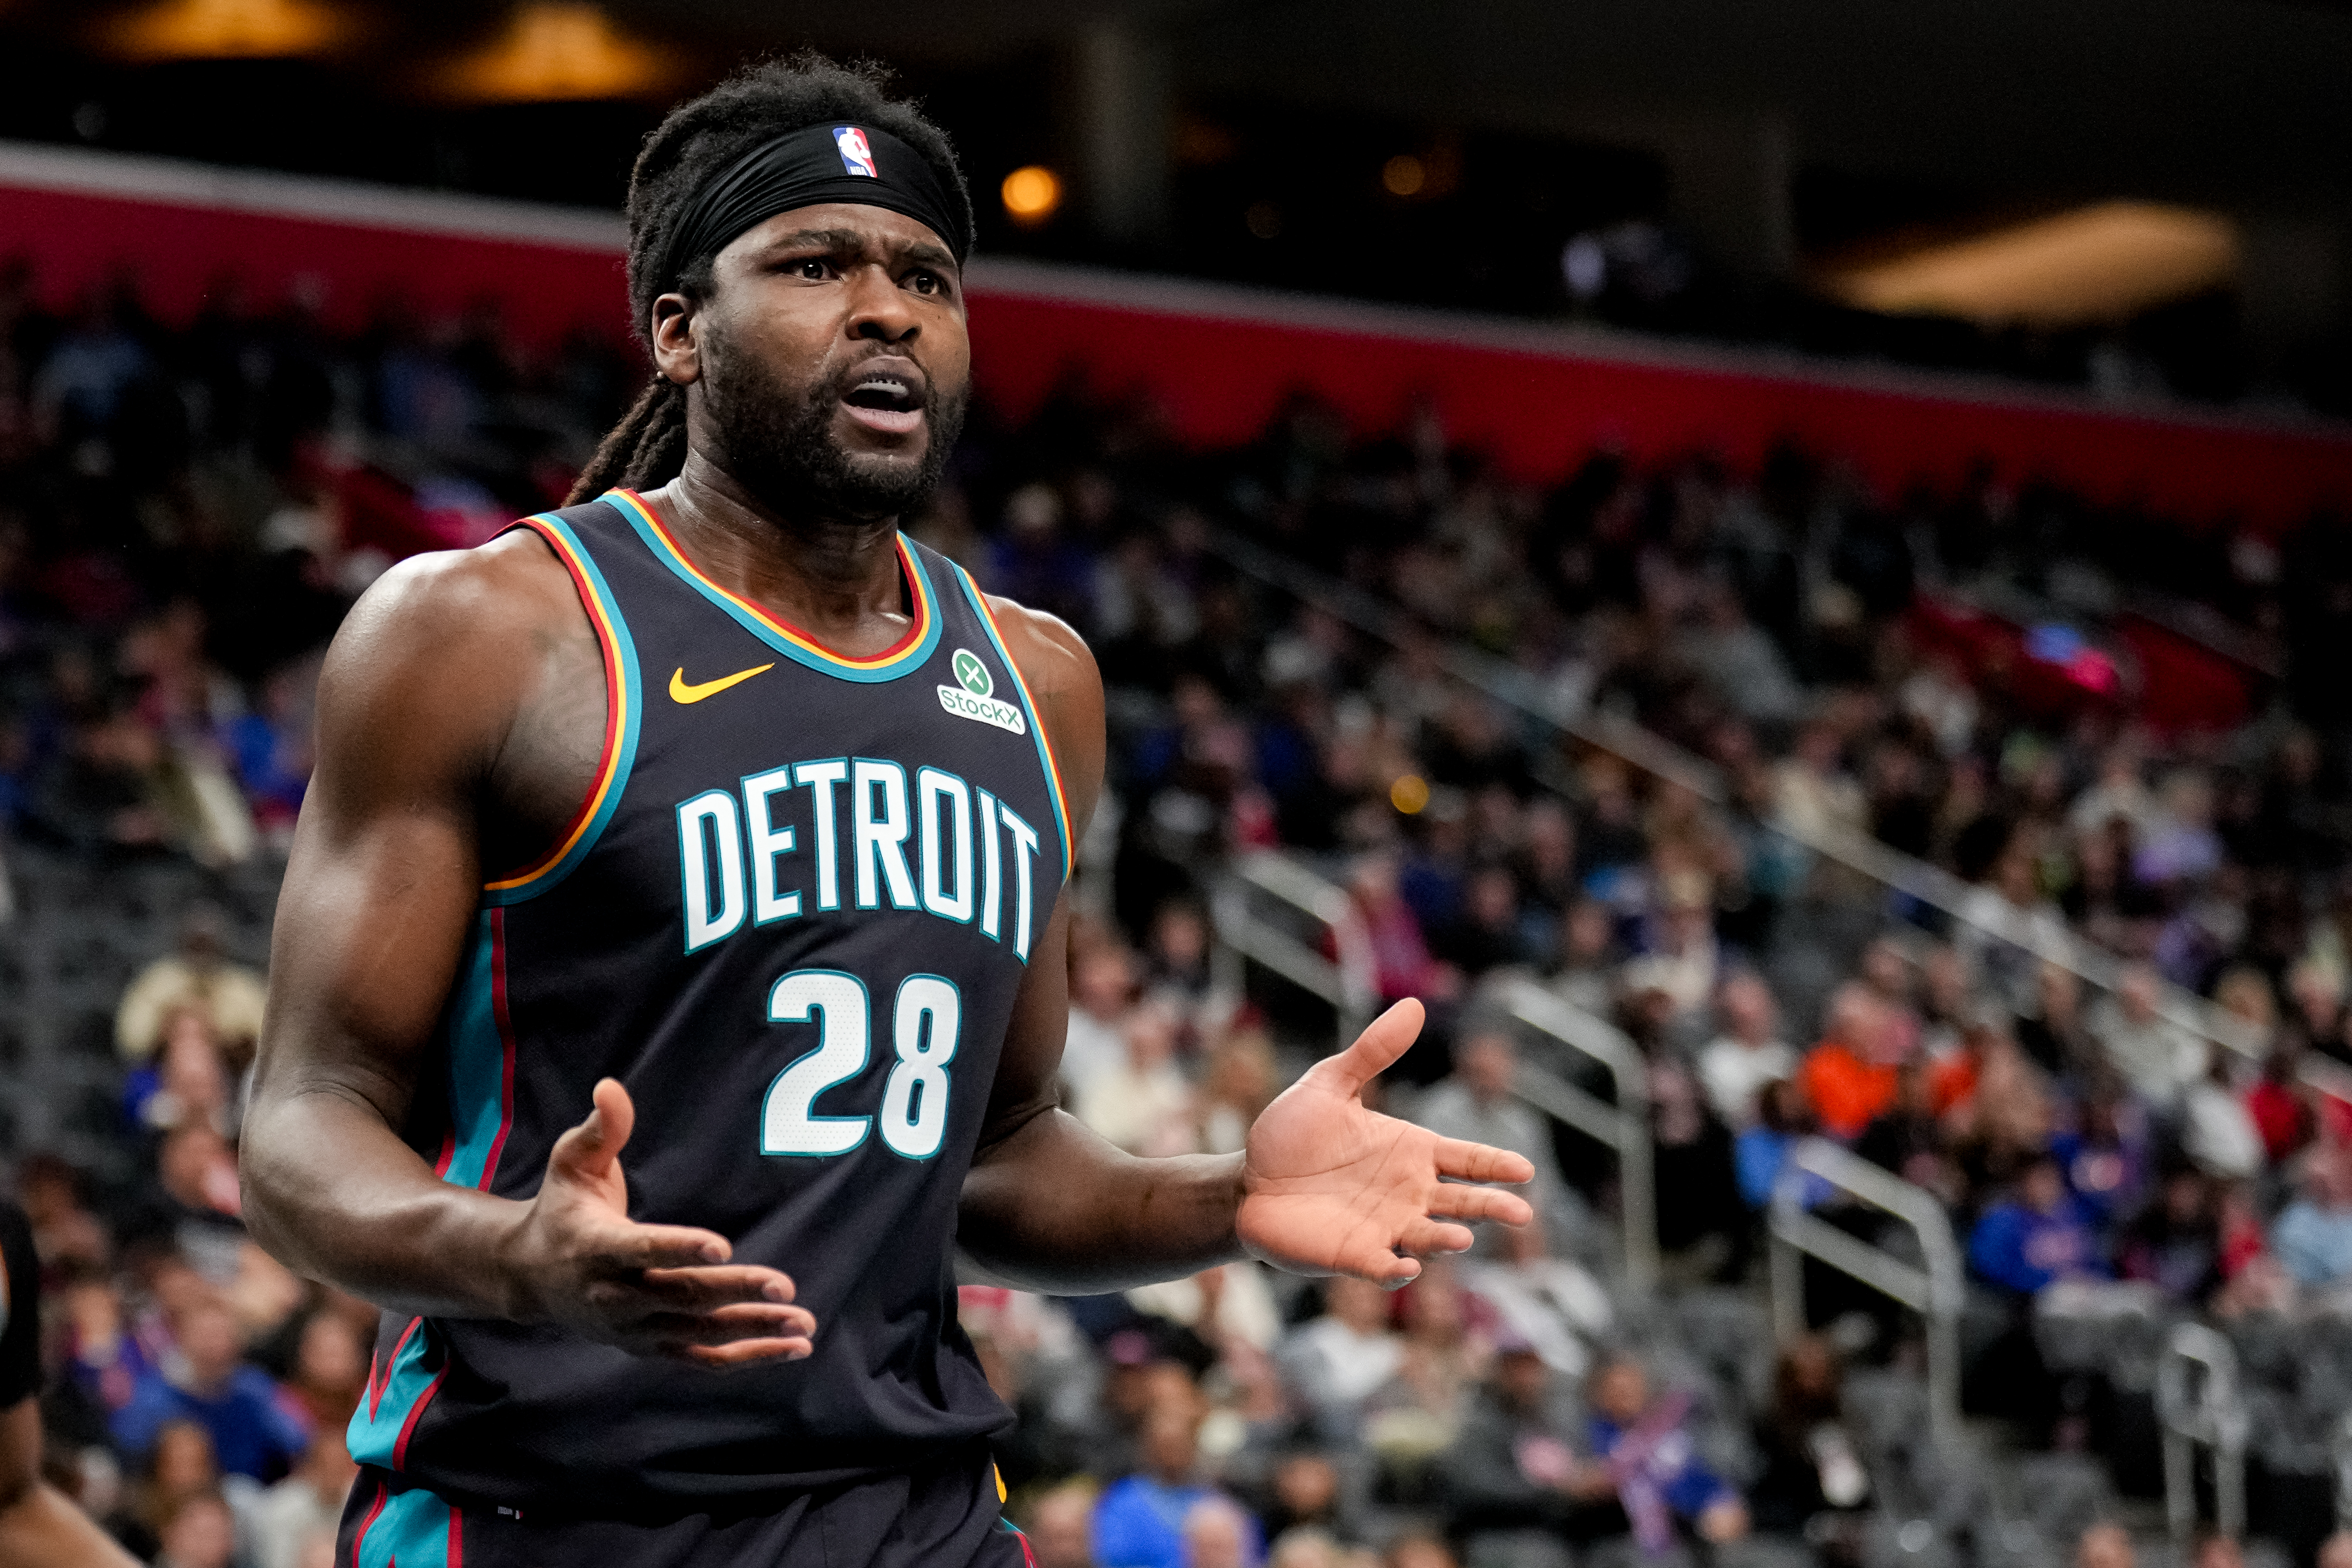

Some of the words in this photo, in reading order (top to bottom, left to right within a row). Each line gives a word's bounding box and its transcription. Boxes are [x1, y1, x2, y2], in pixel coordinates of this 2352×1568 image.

[850, 166, 867, 175] NBA
[941, 690, 1021, 730] StockX
[676, 757, 1040, 966] DETROIT
[760, 968, 962, 1159] 28
